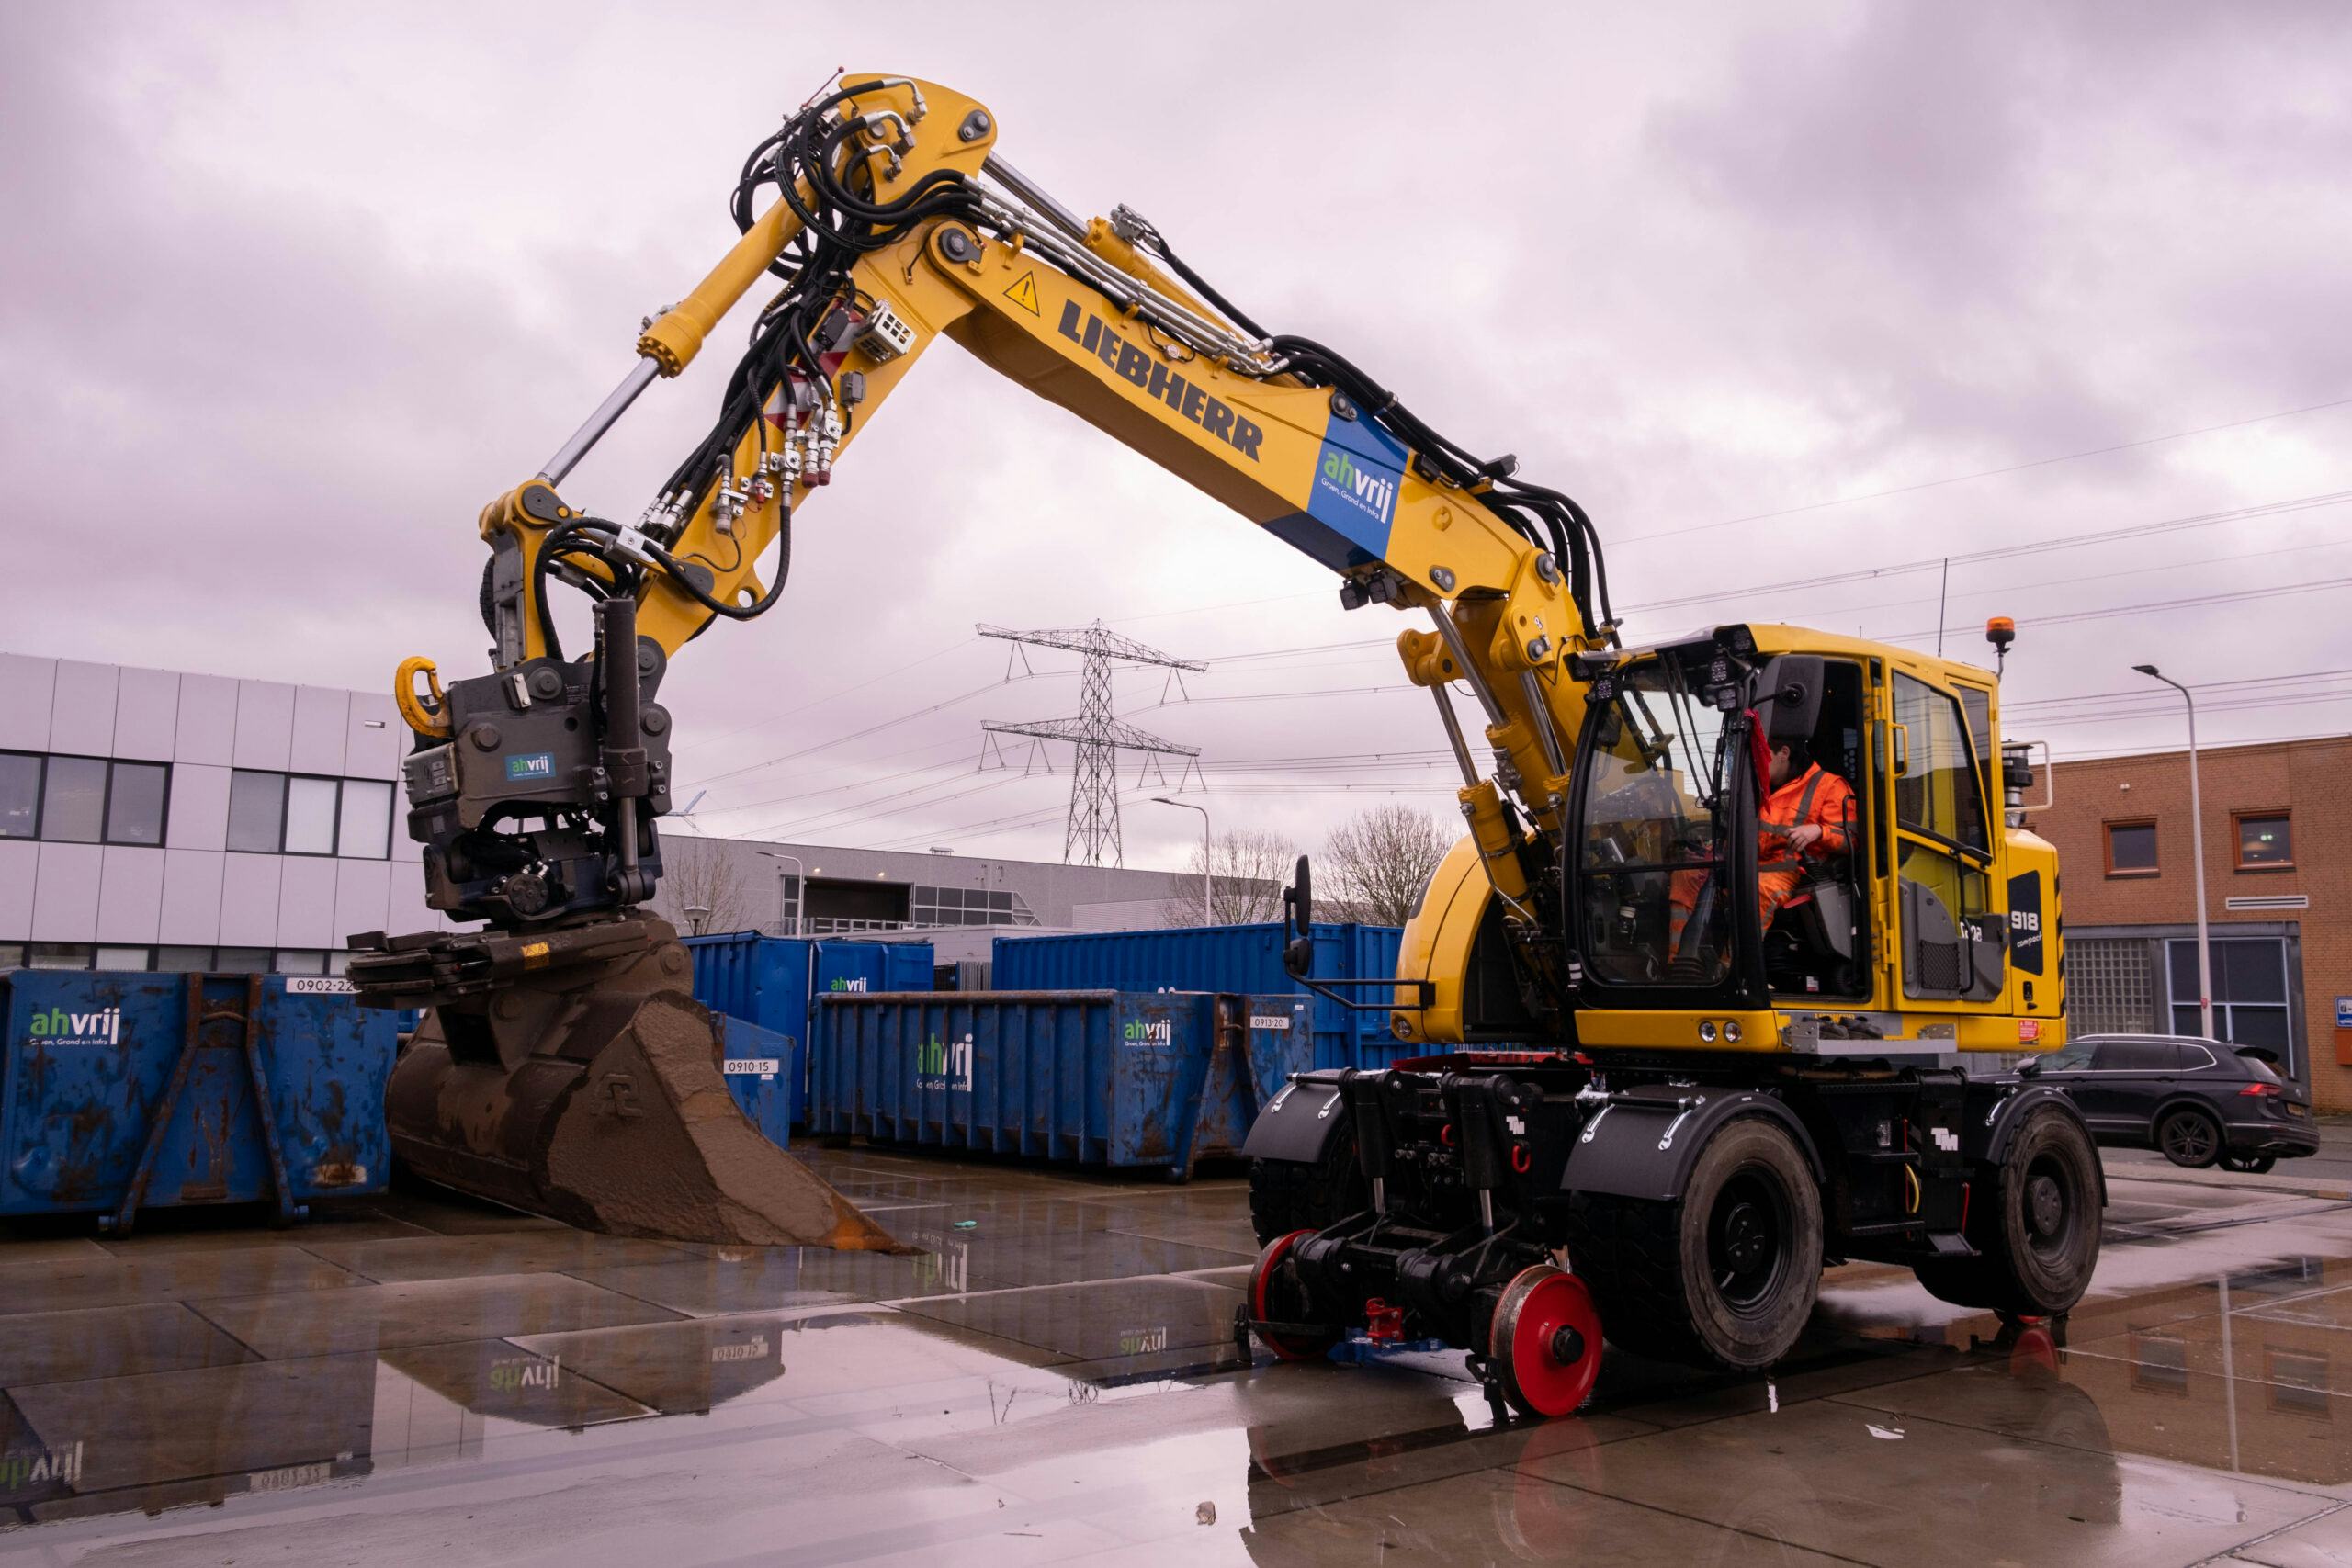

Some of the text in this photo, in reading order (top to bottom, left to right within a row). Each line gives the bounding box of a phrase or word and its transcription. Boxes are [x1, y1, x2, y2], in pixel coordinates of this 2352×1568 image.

[1058, 299, 1262, 463] LIEBHERR
[1324, 451, 1393, 524] ahvrij
[1341, 490, 1359, 507] Grond
[1359, 502, 1366, 512] en
[1367, 507, 1379, 519] Infra
[513, 755, 549, 773] ahvrij
[2011, 911, 2039, 931] 918
[2017, 931, 2042, 948] compact
[297, 979, 354, 992] 0902-22
[831, 976, 867, 993] ahvrij
[30, 1007, 120, 1045] ahvrij
[1254, 1018, 1283, 1027] 0913-20
[1125, 1019, 1170, 1046] ahvrij
[729, 1061, 769, 1072] 0910-15
